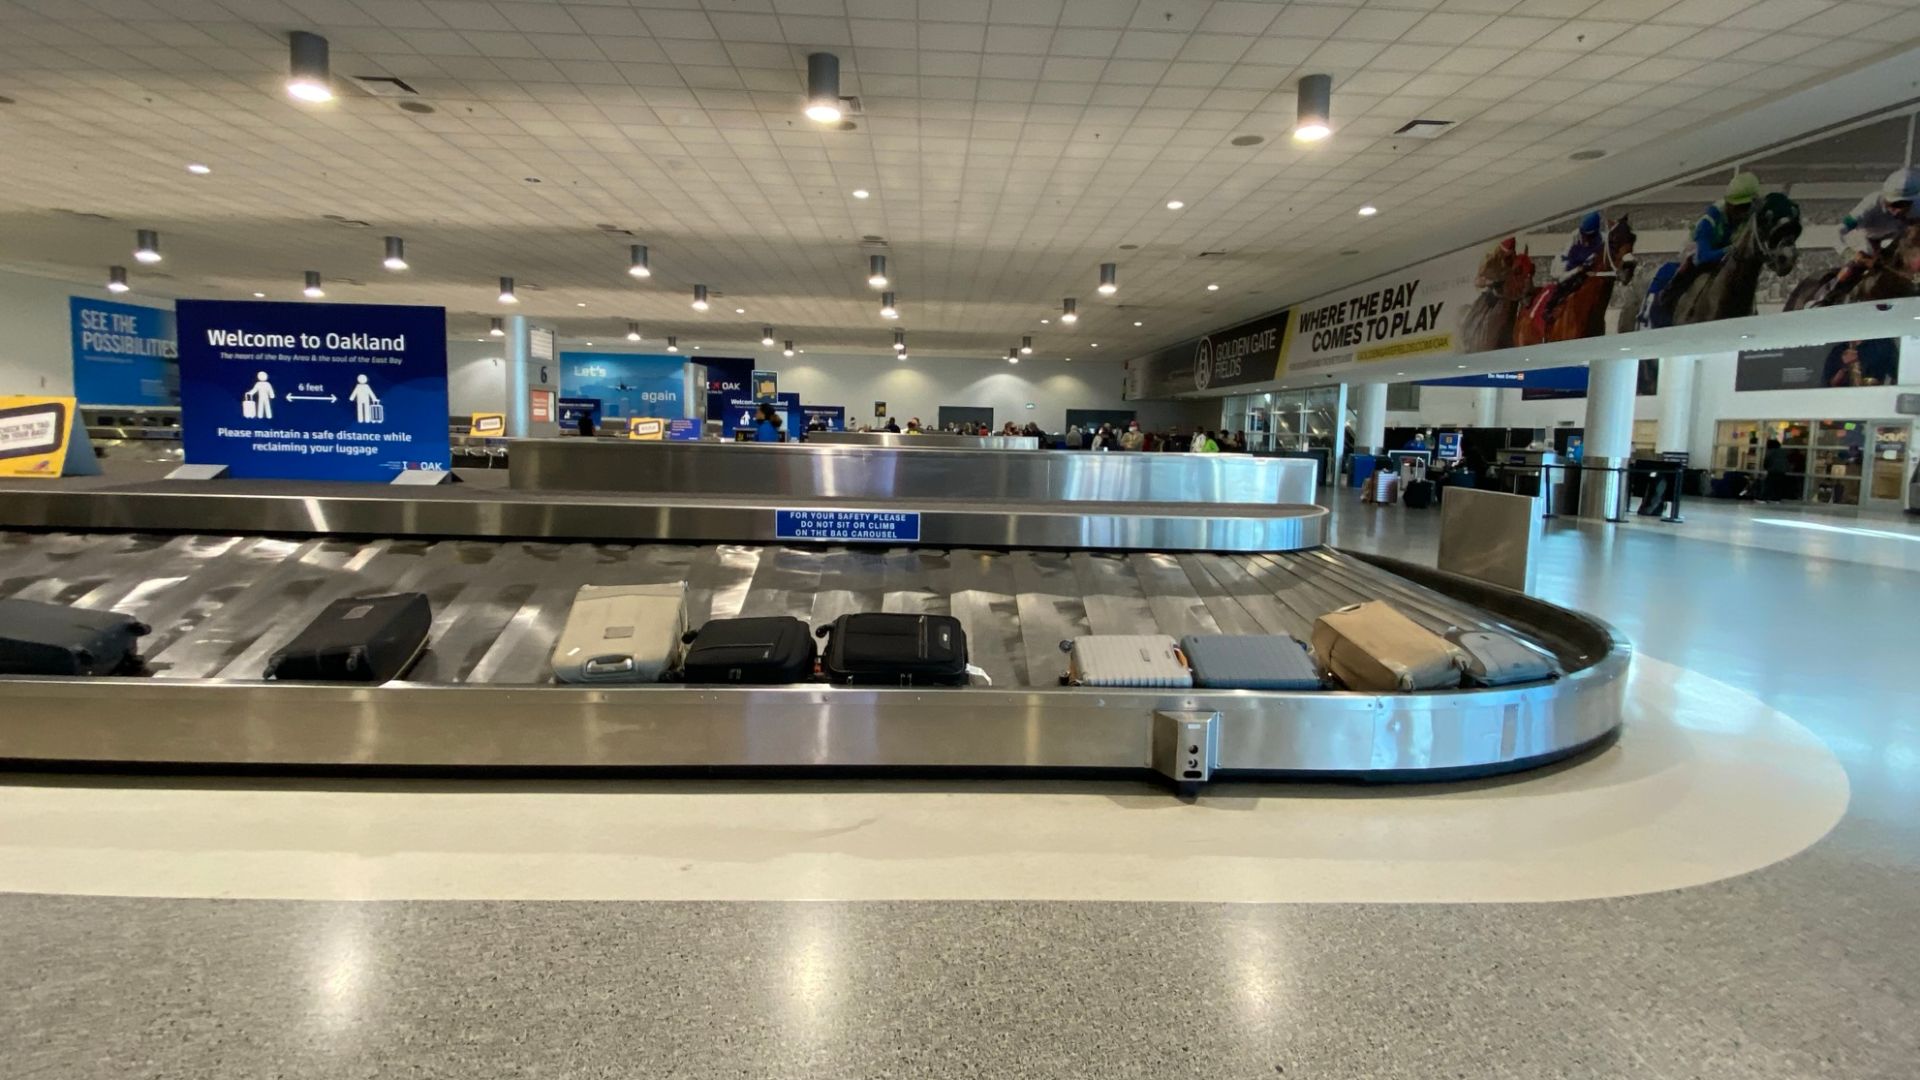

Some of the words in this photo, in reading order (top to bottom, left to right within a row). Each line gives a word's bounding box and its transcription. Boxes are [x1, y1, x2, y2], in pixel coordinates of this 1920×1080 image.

[1299, 301, 1348, 334] WHERE
[1349, 292, 1381, 321] THE
[1381, 280, 1420, 314] BAY
[81, 309, 109, 331] SEE
[111, 313, 138, 335] THE
[1312, 321, 1363, 352] COMES
[1366, 316, 1389, 343] TO
[1390, 302, 1445, 338] PLAY
[82, 331, 178, 358] POSSIBILITIES
[207, 329, 296, 349] Welcome
[299, 332, 321, 349] to
[325, 332, 405, 351] Oakland
[1215, 336, 1250, 361] GOLDEN
[1250, 328, 1278, 353] GATE
[540, 366, 548, 384] 6
[573, 365, 607, 377] Let's
[1215, 358, 1242, 379] FIELDS
[298, 383, 305, 391] 6
[305, 382, 324, 392] feet
[721, 381, 741, 391] OAK
[641, 390, 677, 403] again
[217, 427, 252, 438] Please
[253, 429, 301, 439] maintain
[302, 431, 310, 439] a
[311, 430, 335, 440] safe
[336, 430, 381, 442] distance
[382, 431, 412, 442] while
[252, 442, 308, 454] reclaiming
[309, 443, 334, 454] your
[335, 443, 379, 456] luggage
[402, 461, 408, 470] I
[420, 461, 443, 471] OAK
[789, 511, 808, 520] FOR
[810, 512, 835, 520] YOUR
[837, 513, 871, 521] SAFETY
[873, 513, 907, 521] PLEASE
[800, 520, 813, 528] DO
[816, 520, 834, 529] NOT
[836, 521, 851, 529] SIT
[852, 521, 866, 529] OR
[868, 522, 896, 530] CLIMB
[795, 528, 808, 537] ON
[811, 529, 828, 537] THE
[830, 529, 848, 537] BAG
[850, 530, 898, 538] CAROUSEL
